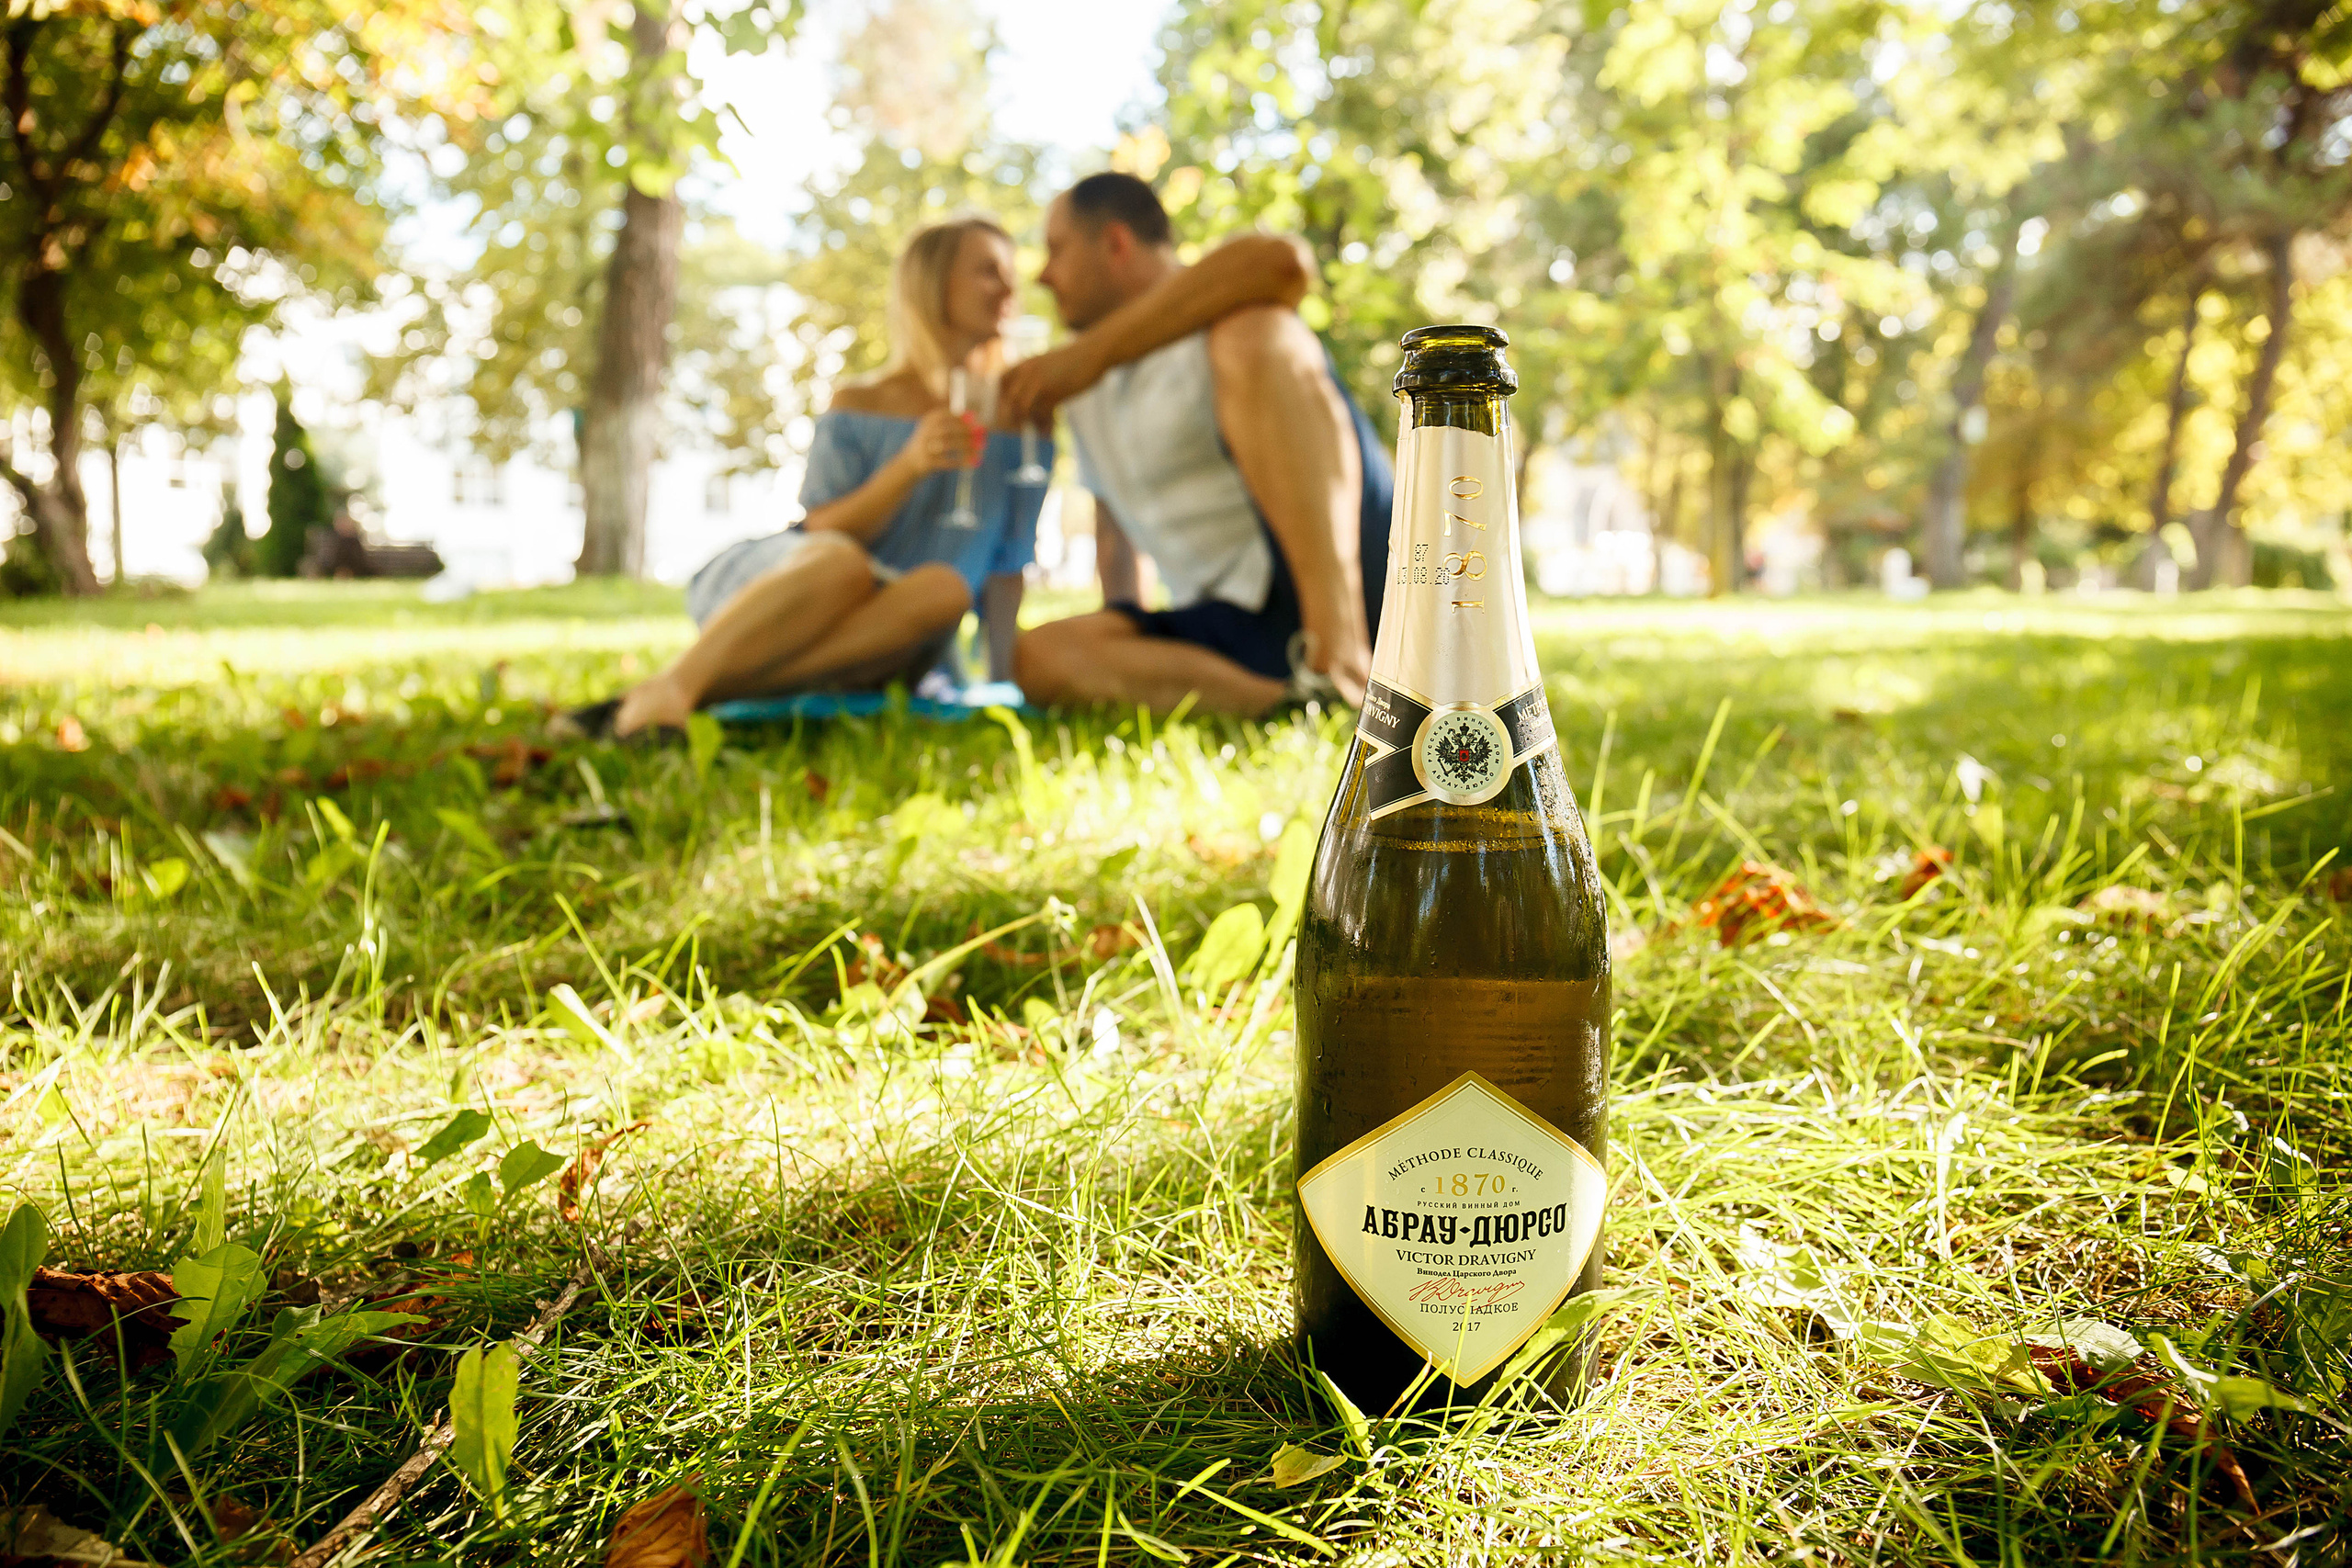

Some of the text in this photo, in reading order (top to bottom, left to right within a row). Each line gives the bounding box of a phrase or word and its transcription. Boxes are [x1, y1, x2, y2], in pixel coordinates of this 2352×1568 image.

[1414, 544, 1429, 562] 87
[1442, 475, 1488, 614] 1870
[1427, 720, 1450, 763] РУССКИЙ
[1456, 716, 1495, 737] ВИННЫЙ
[1387, 1147, 1544, 1181] MÉTHODE CLASSIQUE
[1435, 1173, 1506, 1197] 1870
[1417, 1200, 1521, 1209] РУССКИЙ ВИННЫЙ ДОМ
[1396, 1248, 1537, 1266] VICTOR DRAVIGNY
[1417, 1268, 1517, 1279] Винодел Царского Двора
